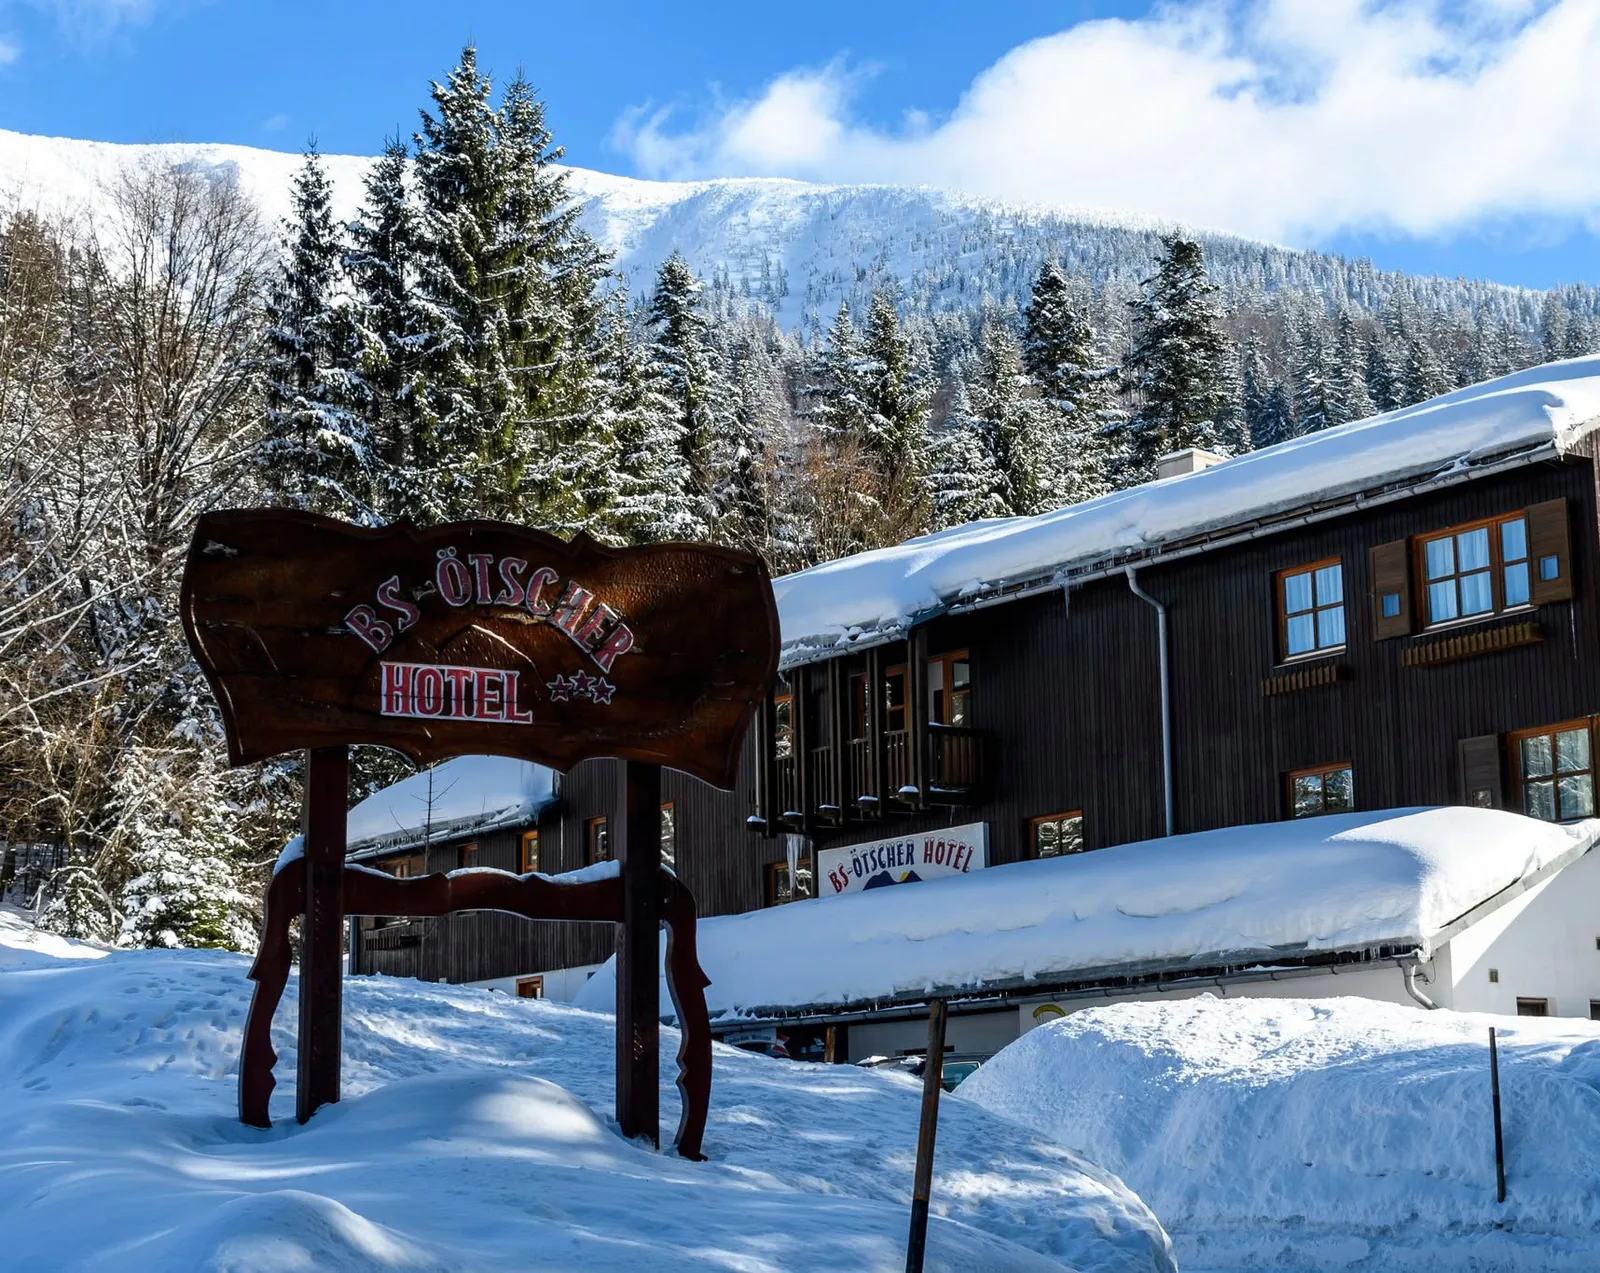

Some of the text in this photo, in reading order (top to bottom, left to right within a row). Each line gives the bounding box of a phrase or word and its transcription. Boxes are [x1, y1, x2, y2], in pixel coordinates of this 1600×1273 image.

[344, 546, 635, 674] BS-ÖTSCHER
[379, 661, 533, 724] HOTEL
[828, 836, 974, 894] BS-ÖTSCHER HOTEL
